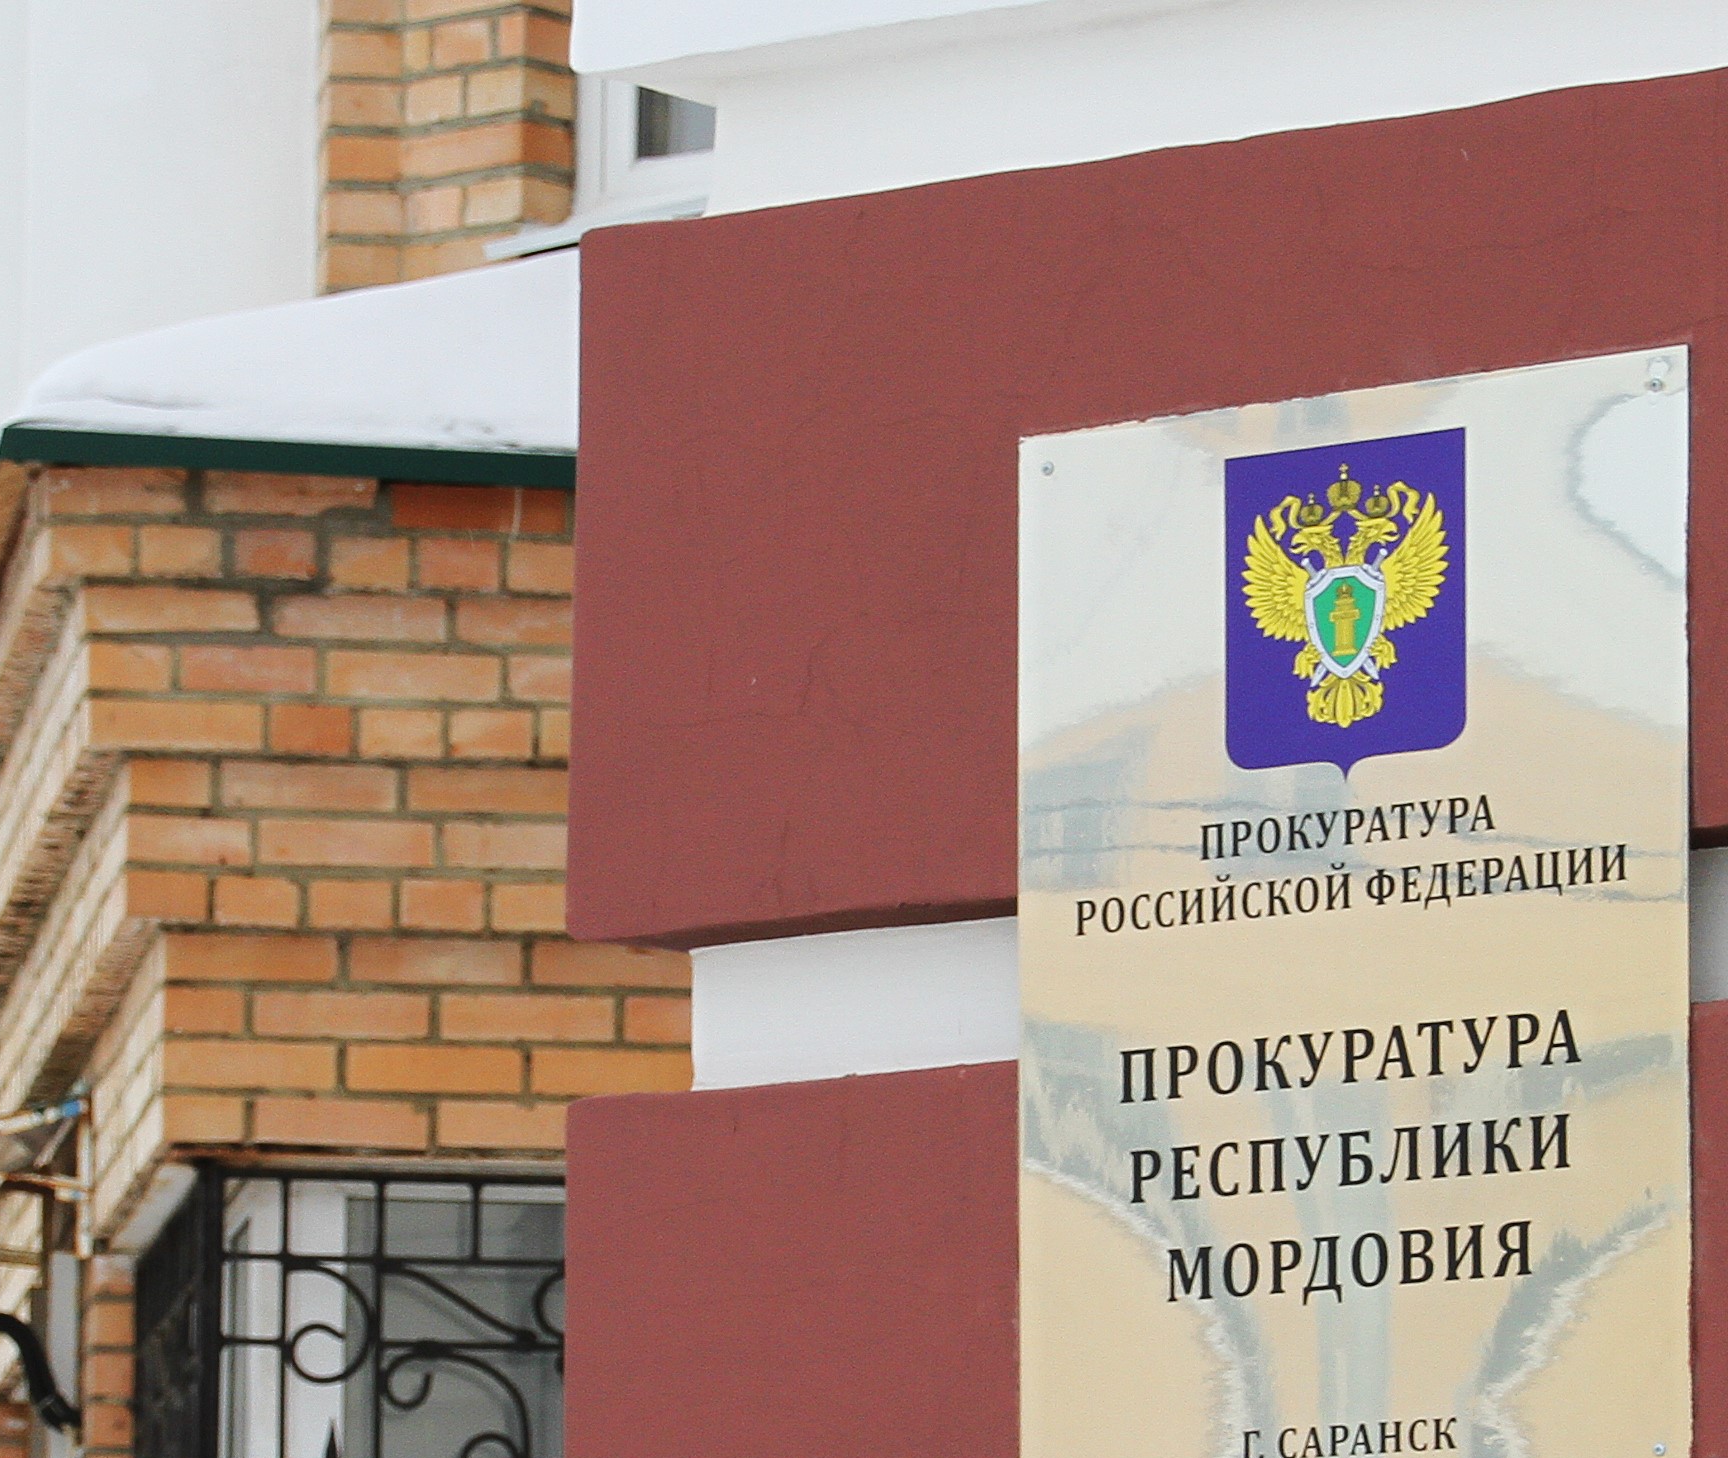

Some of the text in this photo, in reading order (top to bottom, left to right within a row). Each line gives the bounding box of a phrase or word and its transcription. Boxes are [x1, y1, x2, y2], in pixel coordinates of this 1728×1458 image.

[1200, 794, 1495, 861] ПРОКУРАТУРА
[1075, 844, 1627, 936] РОССИЙСКОЙ ФЕДЕРАЦИИ
[1119, 1009, 1582, 1104] ПРОКУРАТУРА
[1129, 1113, 1571, 1205] РЕСПУБЛИКИ
[1167, 1220, 1533, 1306] МОРДОВИЯ
